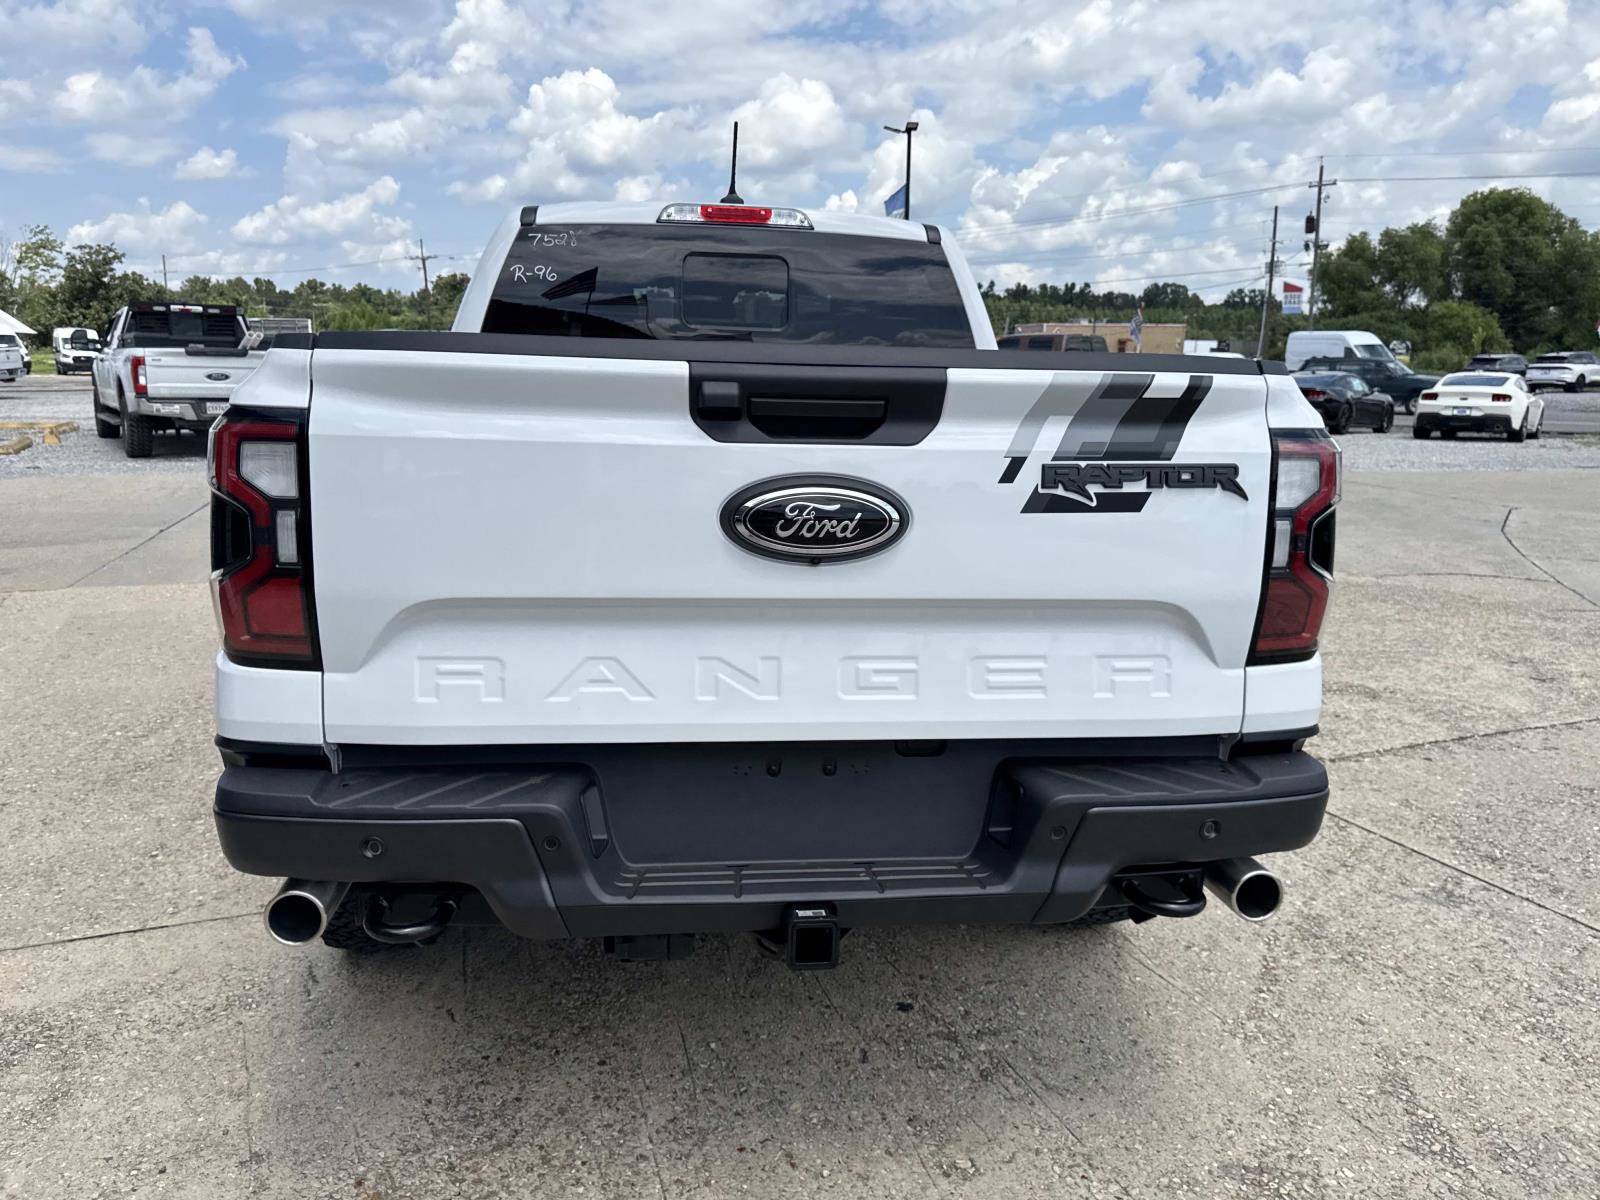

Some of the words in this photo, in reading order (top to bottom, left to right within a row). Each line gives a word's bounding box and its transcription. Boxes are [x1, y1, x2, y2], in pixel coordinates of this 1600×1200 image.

[528, 230, 577, 247] 7528
[510, 264, 558, 283] R-96
[1041, 463, 1249, 502] RAPTOR
[775, 501, 860, 538] Ford
[413, 654, 1173, 705] RANGER
